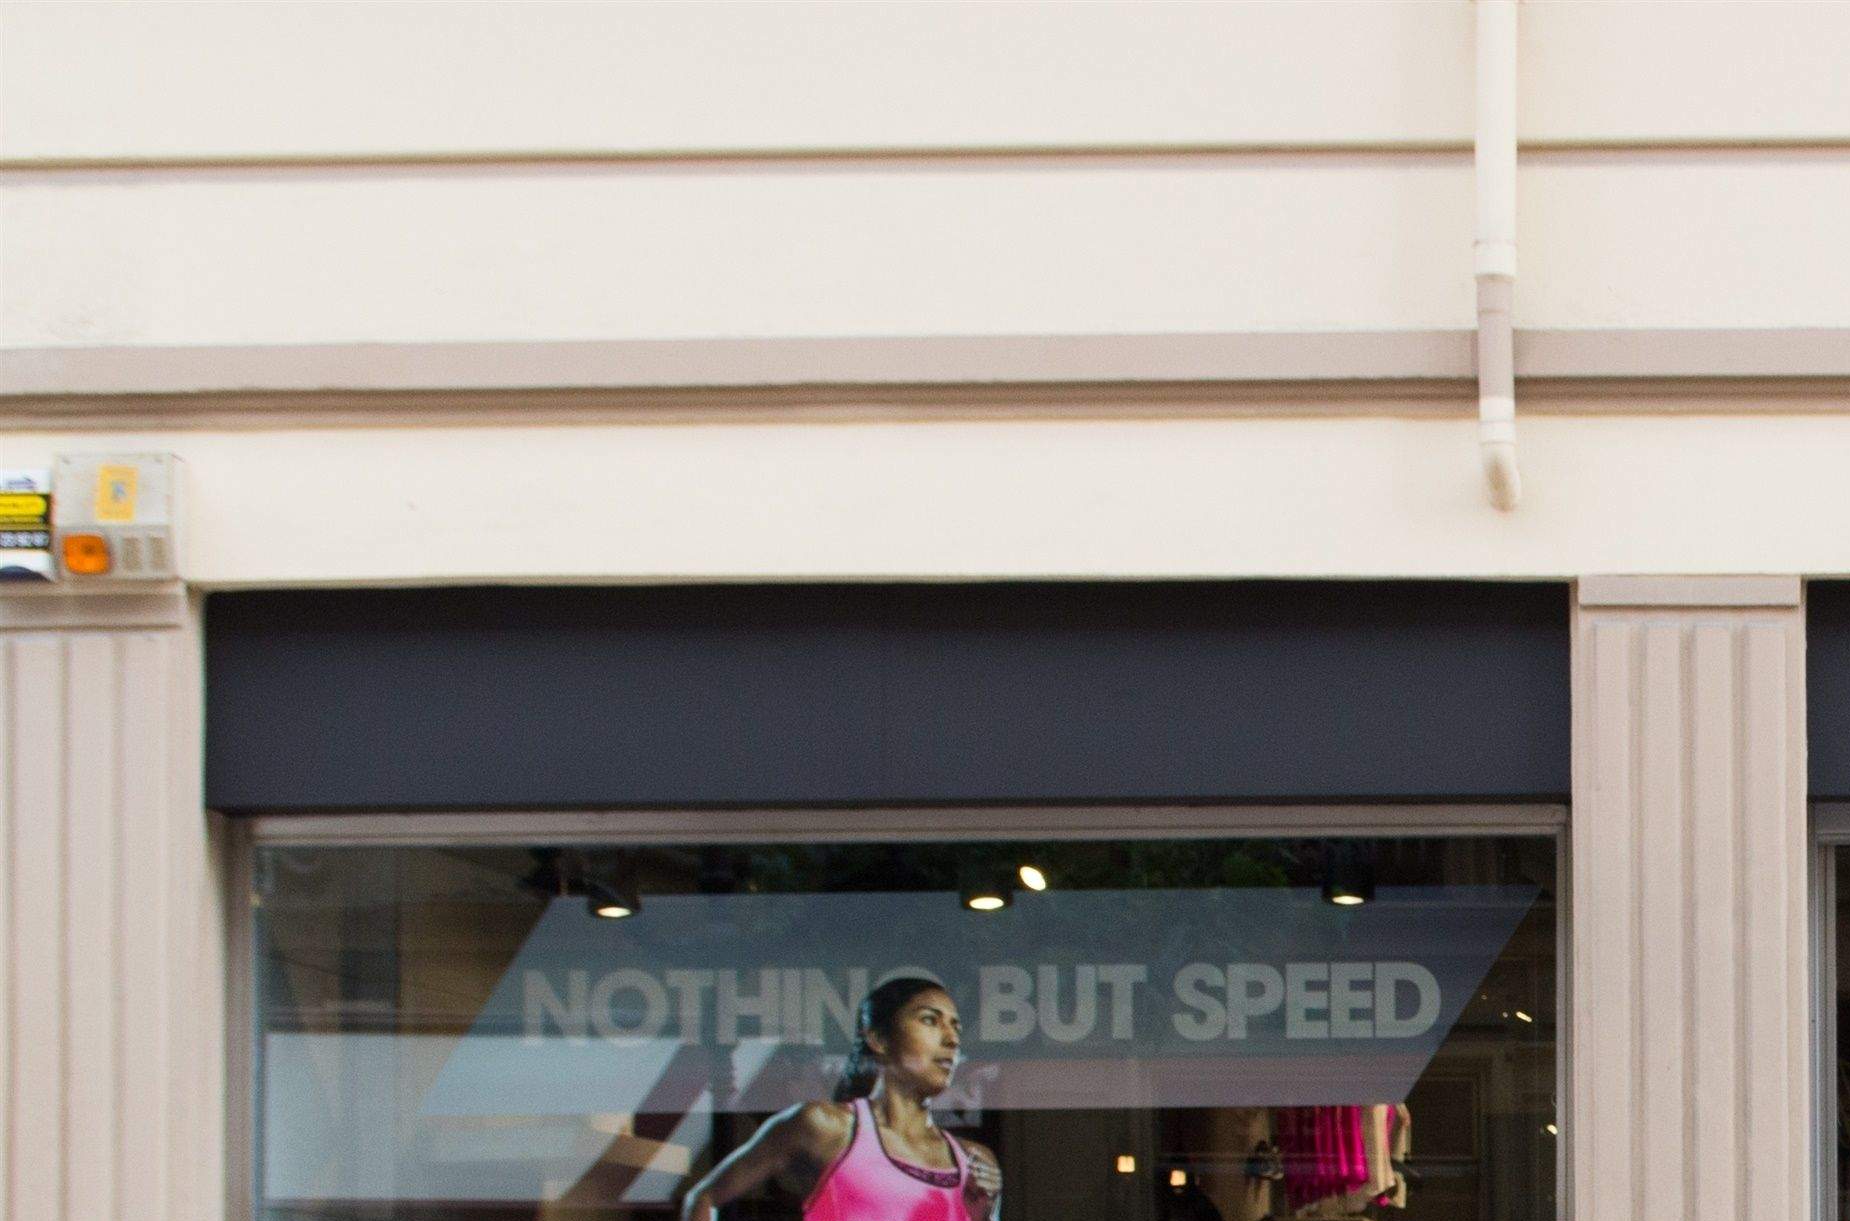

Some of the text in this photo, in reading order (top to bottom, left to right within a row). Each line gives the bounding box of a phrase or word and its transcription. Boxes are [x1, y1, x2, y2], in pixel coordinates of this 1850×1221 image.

[522, 962, 1441, 1046] NOTHIN BUT SPEED
